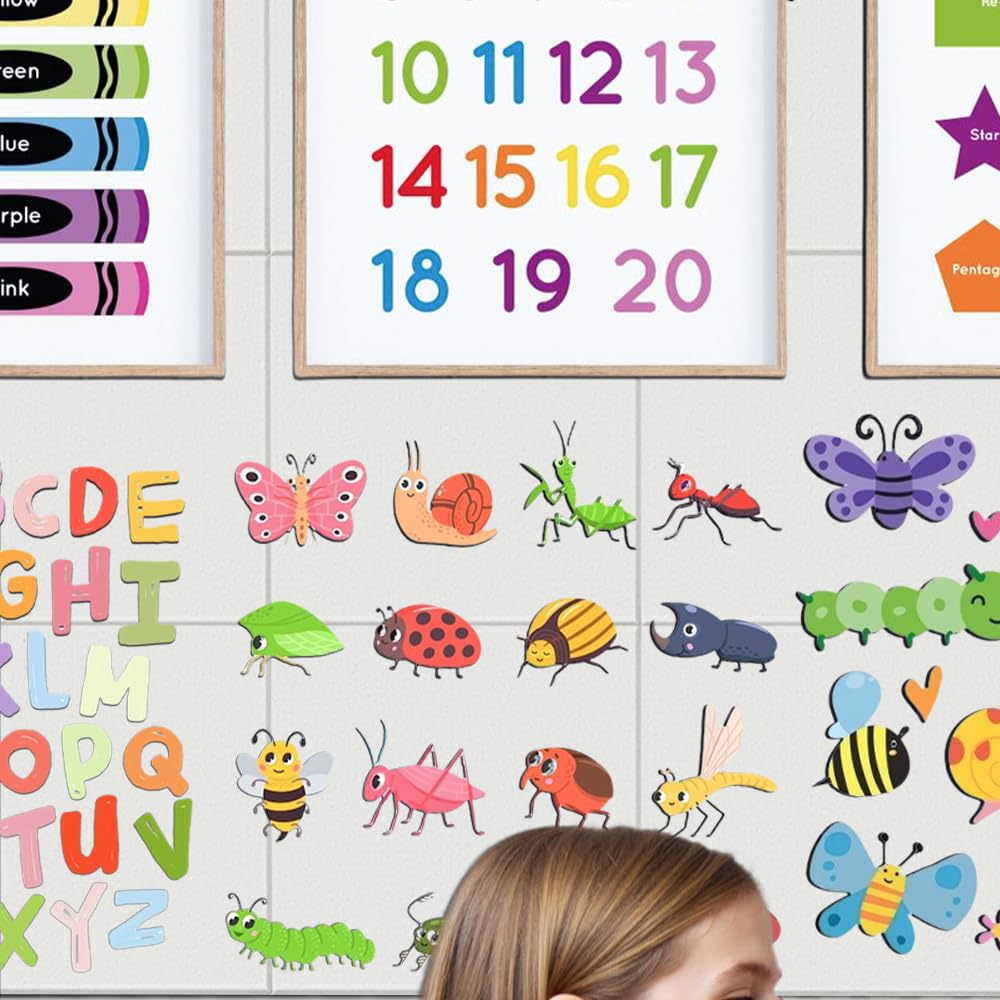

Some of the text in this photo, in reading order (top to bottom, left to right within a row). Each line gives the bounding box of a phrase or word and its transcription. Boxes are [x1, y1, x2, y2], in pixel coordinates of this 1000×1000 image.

[0, 66, 39, 79] een
[372, 40, 715, 105] 10 11 12 13
[970, 128, 1000, 141] Star
[371, 144, 718, 209] 14 15 16 17
[371, 248, 711, 313] 18 19 20
